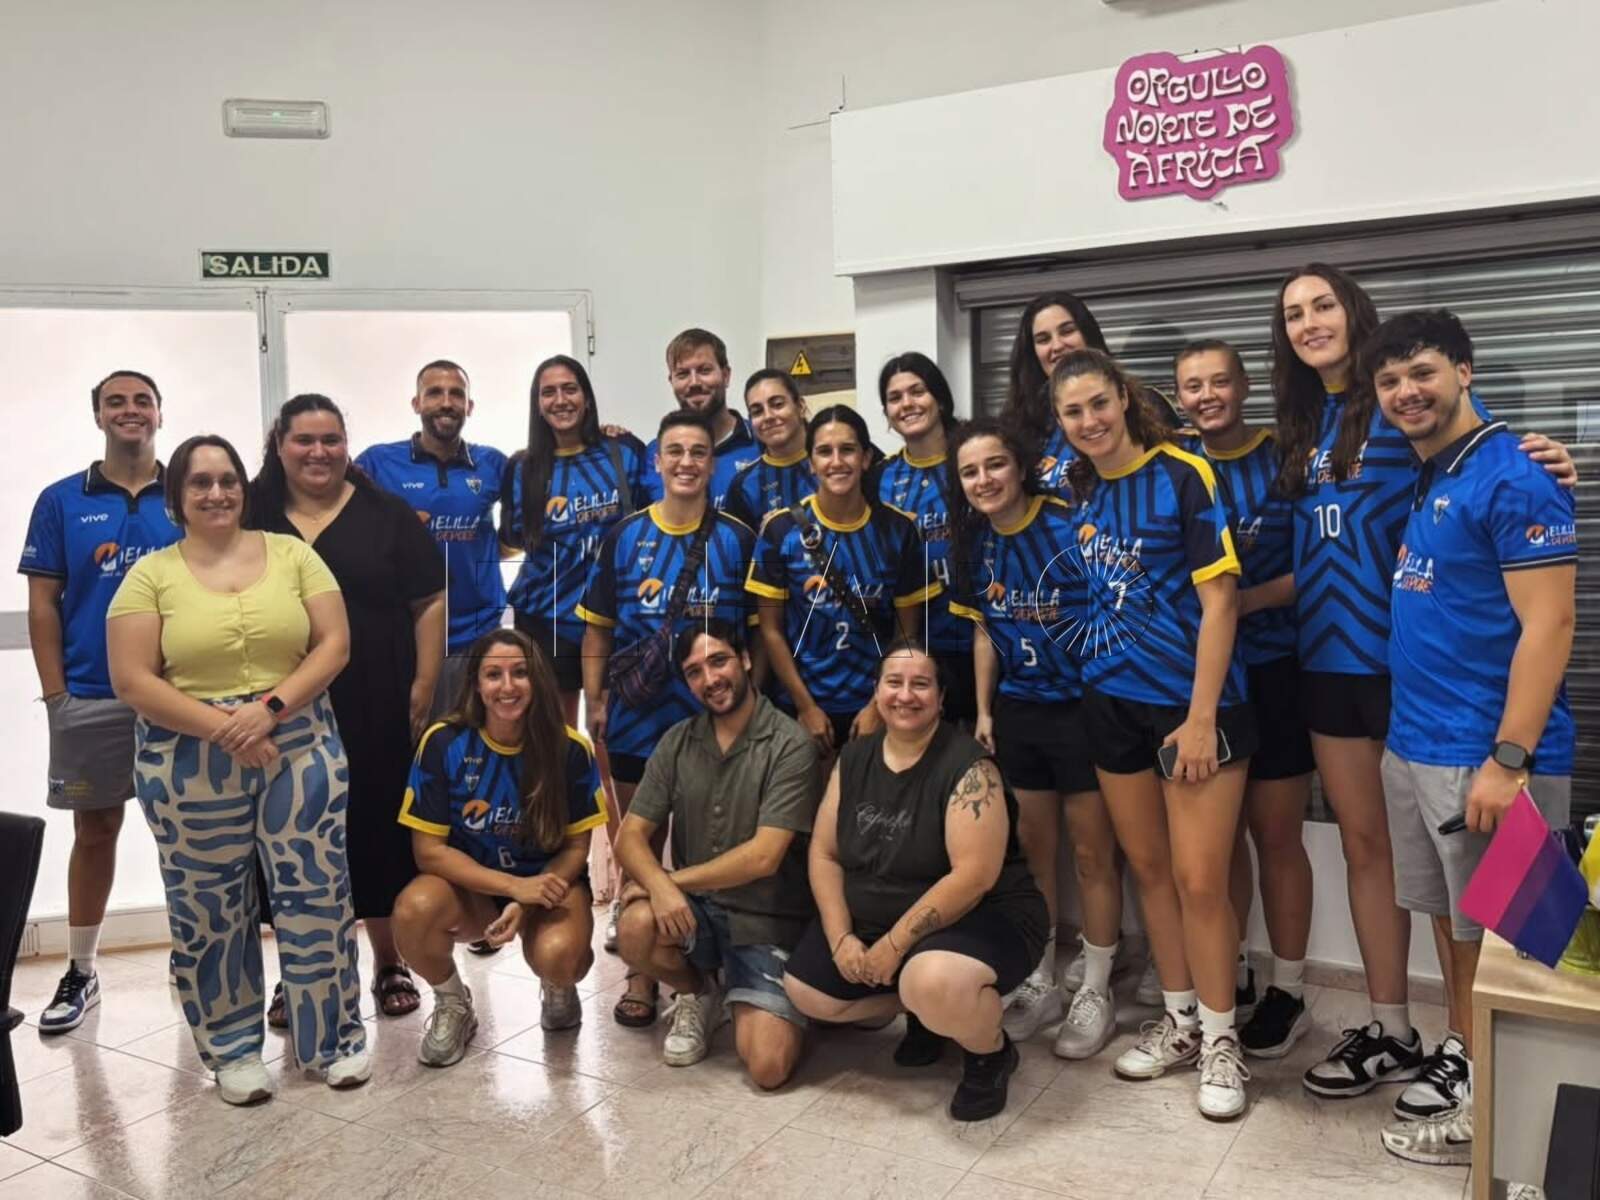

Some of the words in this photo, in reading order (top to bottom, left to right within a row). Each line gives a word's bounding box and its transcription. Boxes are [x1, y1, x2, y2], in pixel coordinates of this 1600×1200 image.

[1127, 62, 1266, 107] ORGULLO
[1115, 108, 1217, 145] NORTE
[1224, 94, 1277, 138] DE
[209, 255, 323, 276] SALIDA
[80, 513, 110, 523] vive
[1313, 503, 1342, 539] 10
[933, 557, 950, 585] 4
[1107, 580, 1127, 610] 7
[835, 621, 851, 651] 2
[1020, 637, 1038, 667] 5
